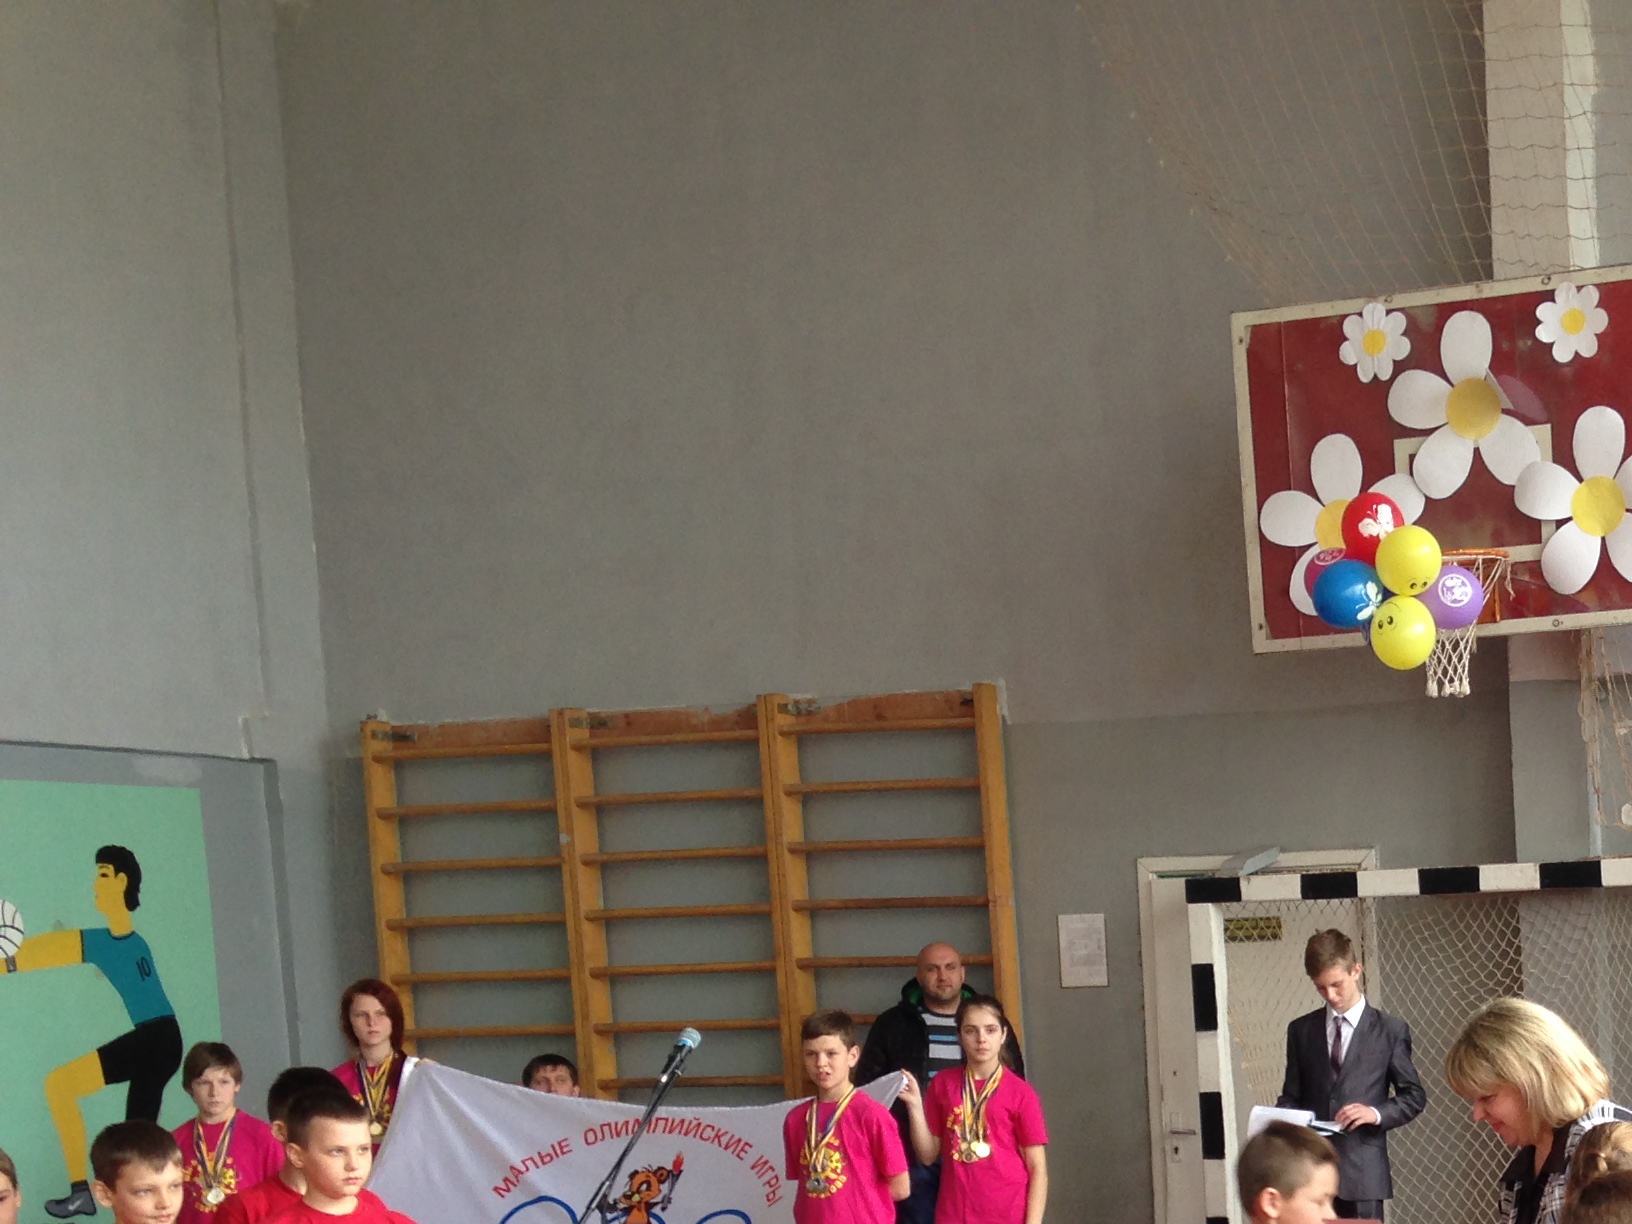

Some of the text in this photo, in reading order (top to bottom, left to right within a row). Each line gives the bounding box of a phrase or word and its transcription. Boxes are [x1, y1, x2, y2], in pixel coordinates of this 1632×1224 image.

[135, 956, 151, 981] 10
[492, 1137, 573, 1199] МАЛЫЕ
[583, 1116, 753, 1161] ОЛИМПИЙСКИЕ
[750, 1153, 784, 1207] ИГРЫ
